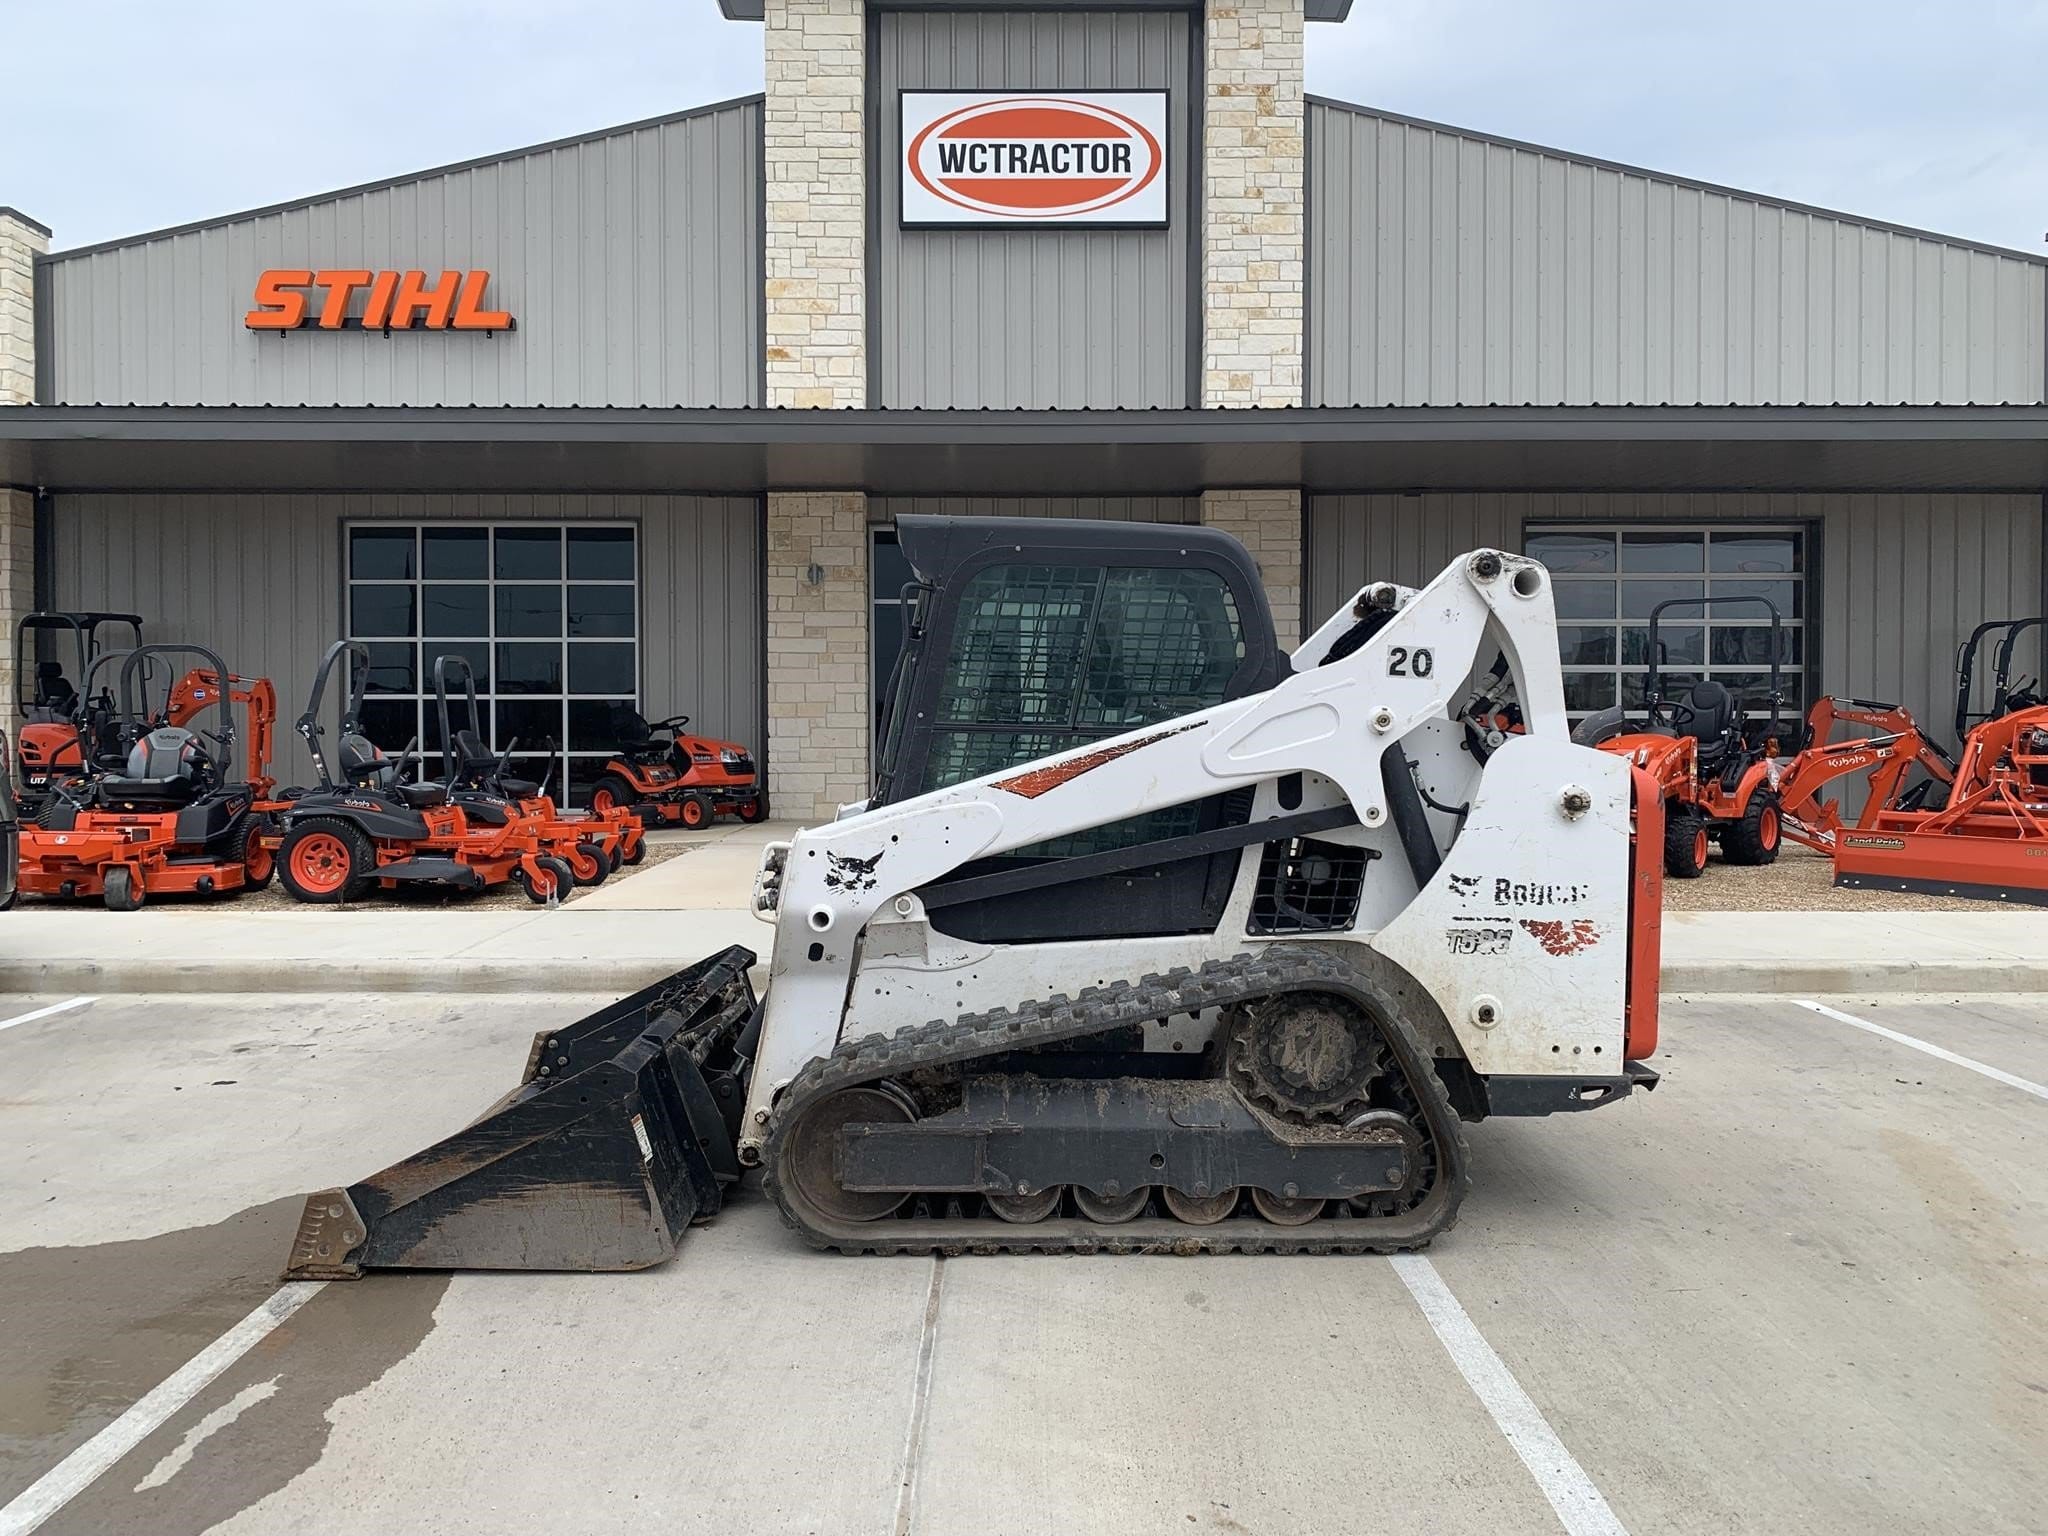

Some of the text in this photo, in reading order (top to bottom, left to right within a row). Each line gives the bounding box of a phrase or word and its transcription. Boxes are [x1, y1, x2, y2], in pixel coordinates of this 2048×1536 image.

[938, 143, 1132, 174] WCTRACTOR
[245, 269, 513, 329] STIHL
[1389, 647, 1433, 678] 20
[1828, 755, 1866, 768] Kubota
[30, 777, 47, 785] U17
[344, 798, 370, 808] Kubota
